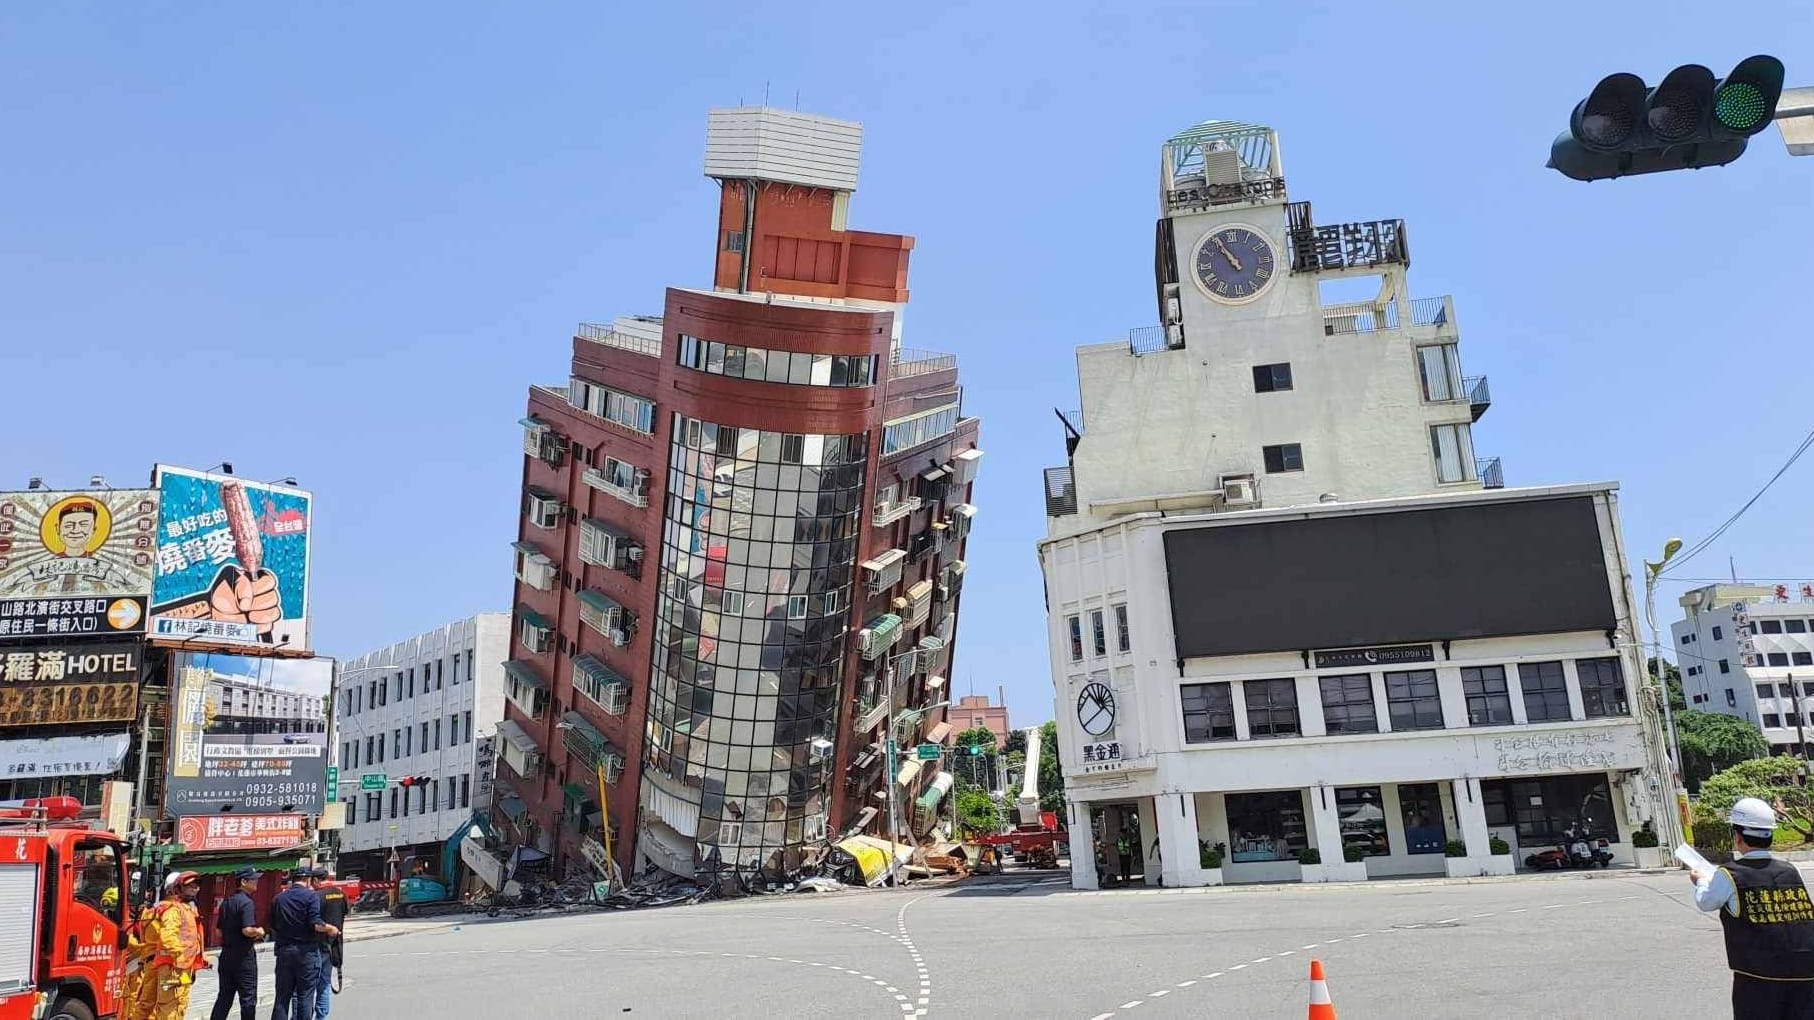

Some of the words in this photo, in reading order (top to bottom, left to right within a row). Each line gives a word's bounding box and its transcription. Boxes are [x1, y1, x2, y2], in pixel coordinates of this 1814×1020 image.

[166, 509, 228, 538] 最好吃的
[157, 527, 236, 576] 燒番麥
[1, 600, 107, 617] 山路北濱街交叉路口
[0, 651, 66, 681] 羅滿
[67, 653, 137, 675] HOTEL
[1083, 743, 1120, 762] 黑金通
[246, 782, 317, 795] 0932-581018
[245, 794, 316, 808] 0905-935071
[207, 816, 253, 837] 胖老爹
[16, 838, 27, 859] 花
[1745, 887, 1808, 904] 花蓮縣政府
